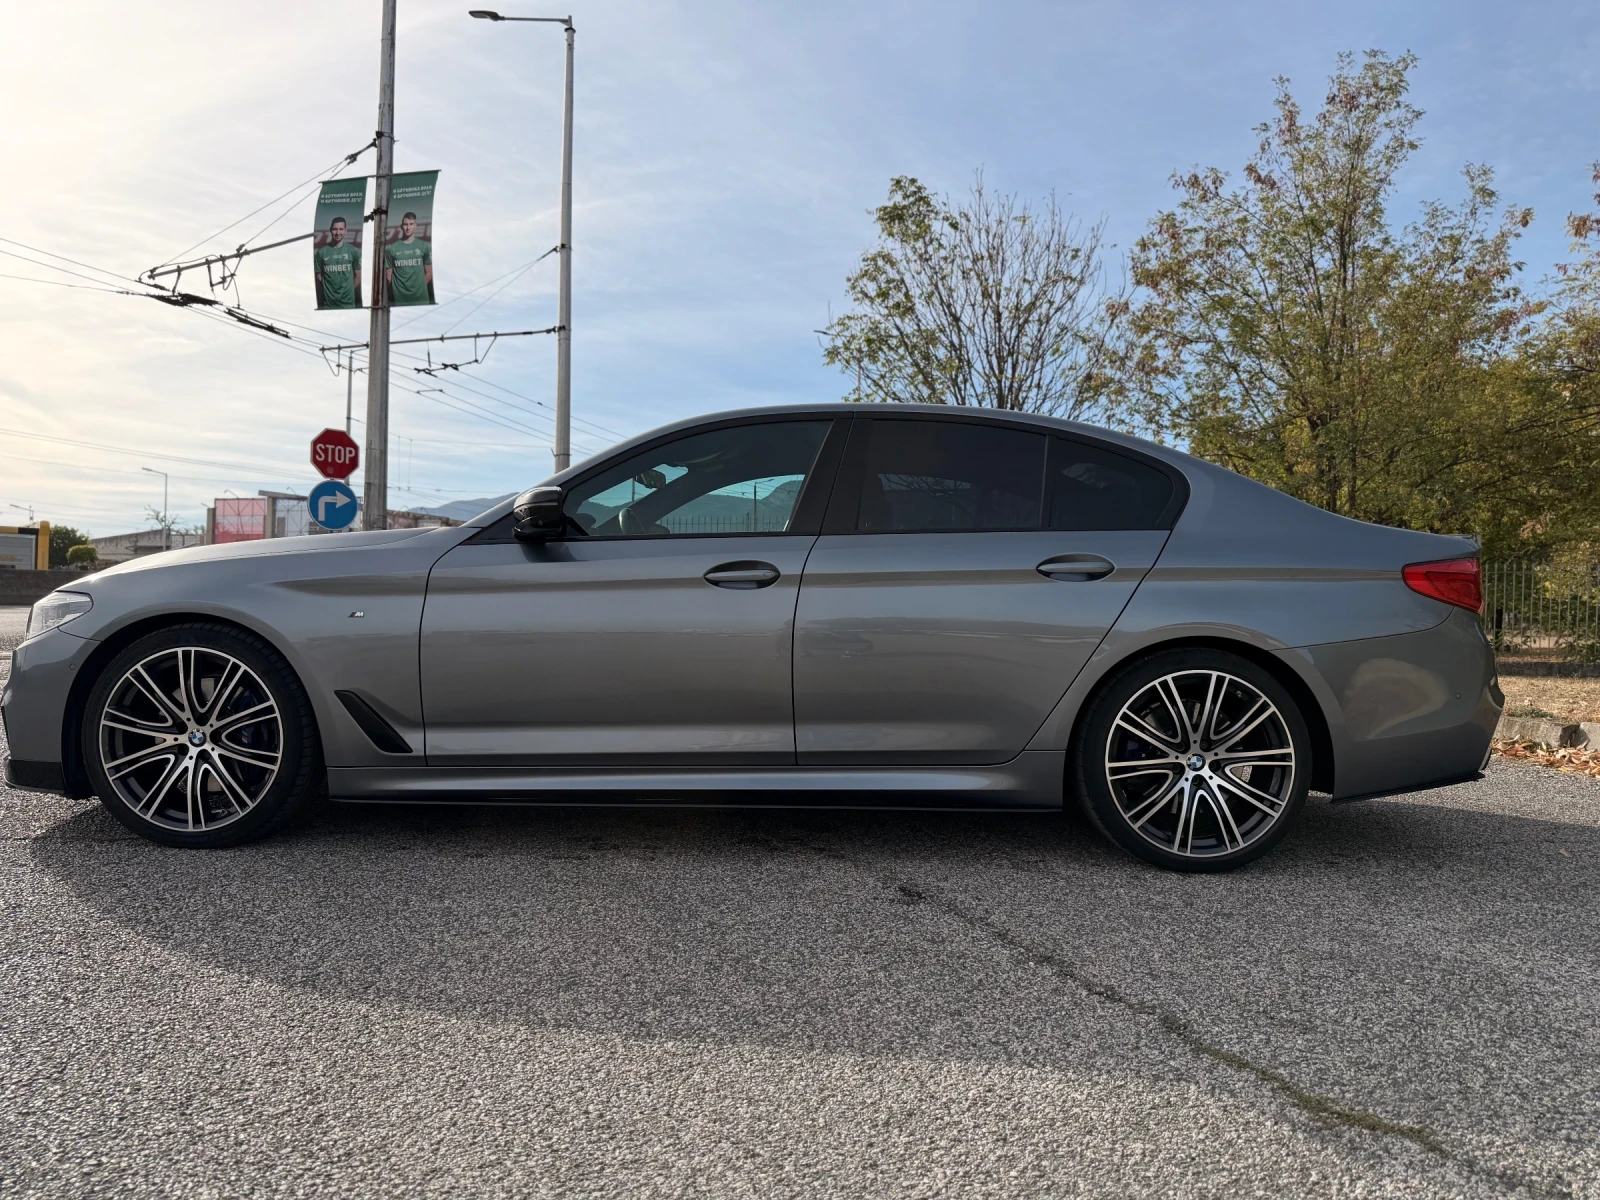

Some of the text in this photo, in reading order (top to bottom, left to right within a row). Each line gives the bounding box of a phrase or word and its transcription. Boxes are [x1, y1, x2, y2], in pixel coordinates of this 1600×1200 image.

[394, 258, 422, 267] WINBET
[323, 263, 352, 272] WINBET
[315, 443, 356, 465] STOP
